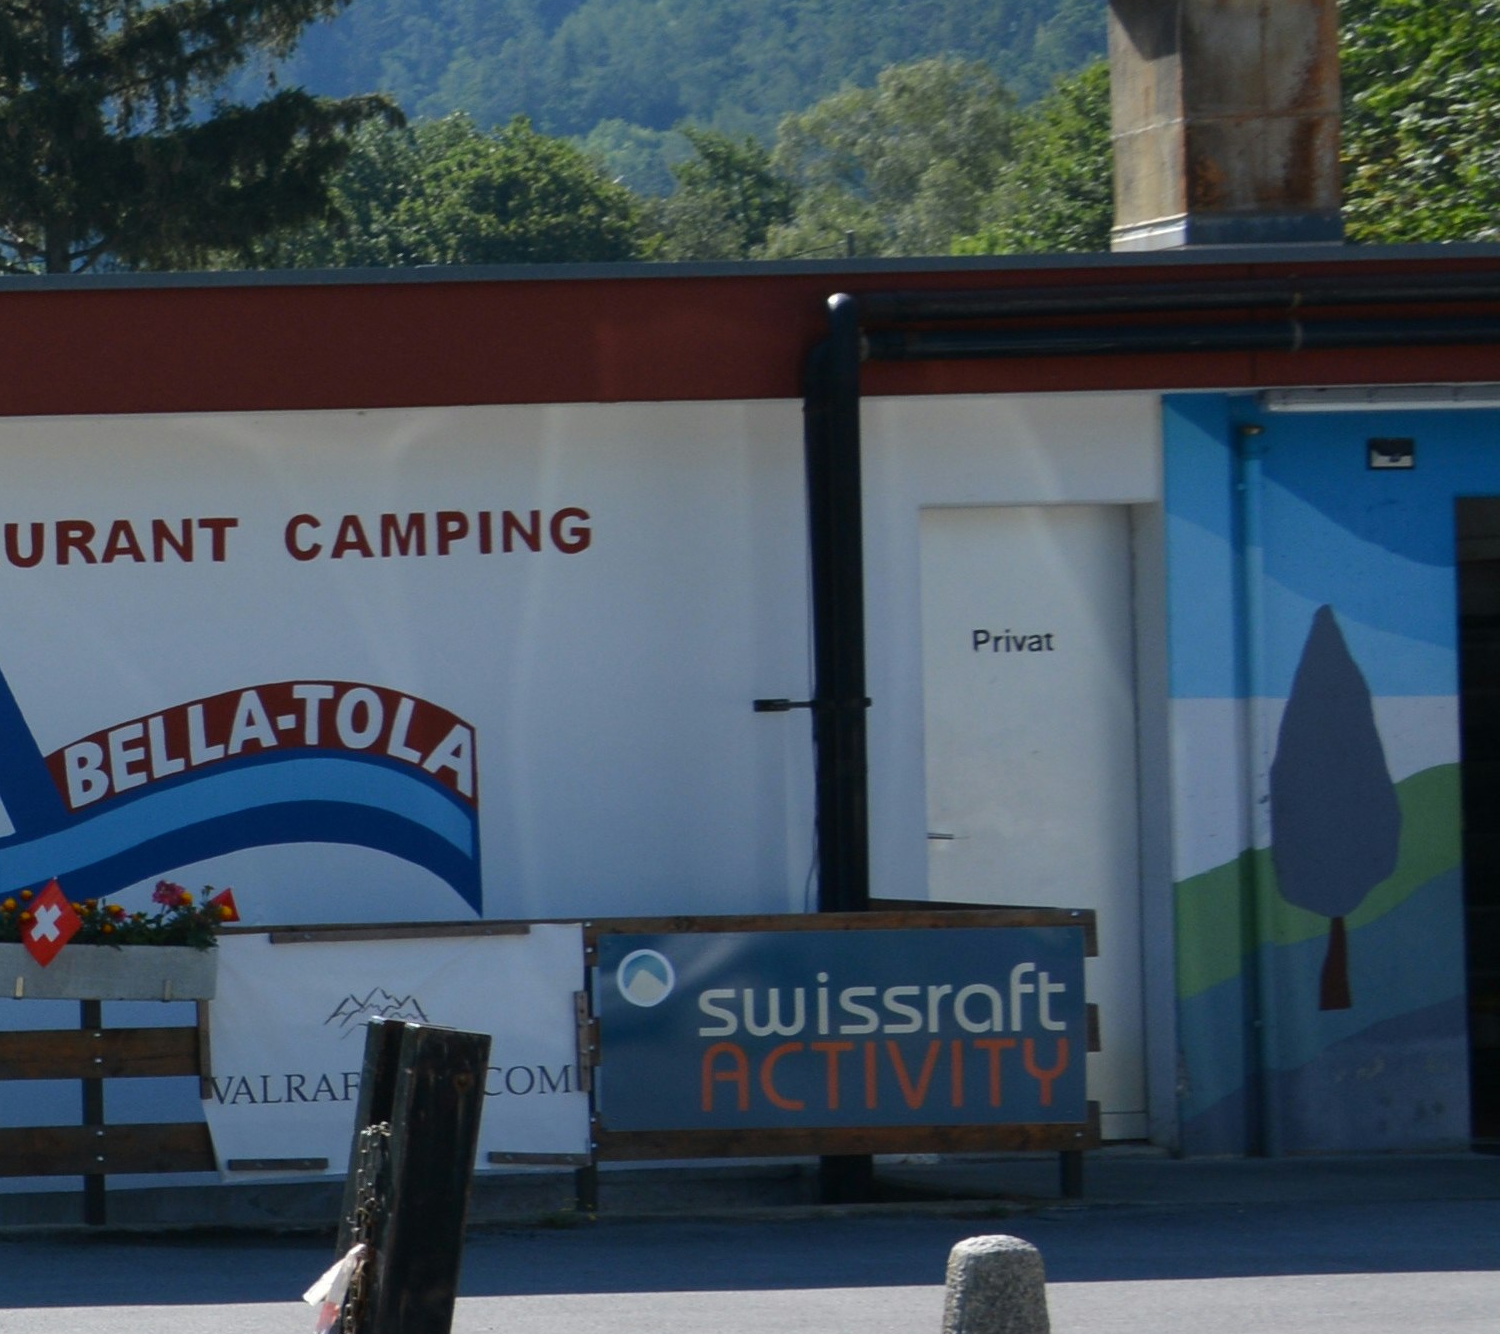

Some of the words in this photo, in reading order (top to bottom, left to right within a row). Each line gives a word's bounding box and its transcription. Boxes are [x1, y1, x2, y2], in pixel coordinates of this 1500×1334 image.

[284, 506, 593, 562] CAMPING
[971, 628, 1055, 654] Privat
[64, 684, 476, 811] BELLA-TOLA
[698, 962, 1067, 1036] swissraft
[702, 1038, 1070, 1112] ACTIVITY
